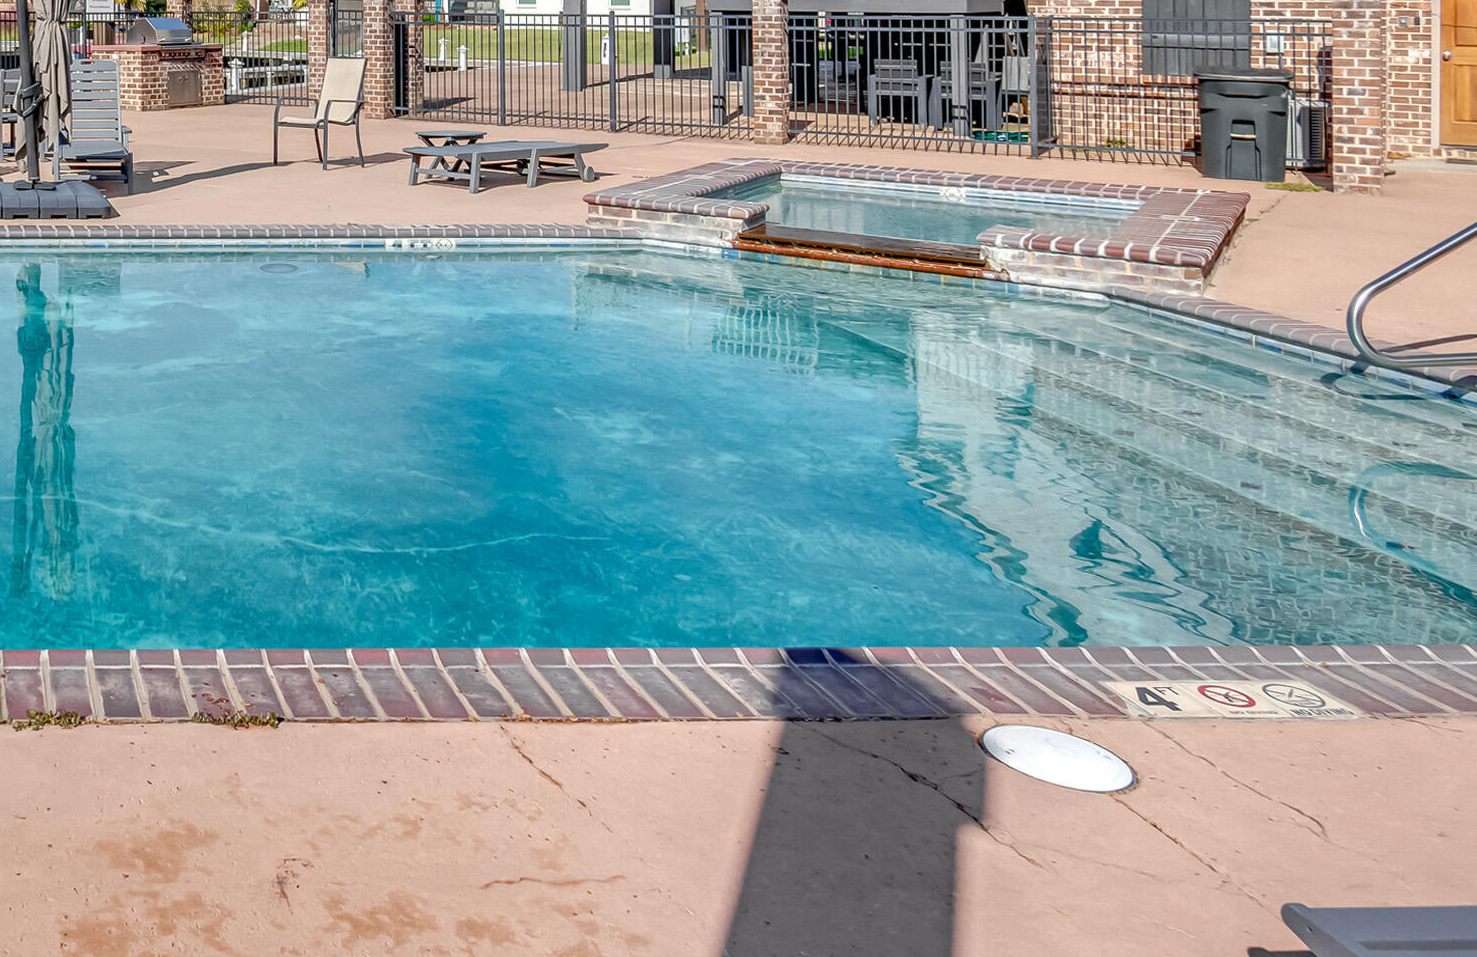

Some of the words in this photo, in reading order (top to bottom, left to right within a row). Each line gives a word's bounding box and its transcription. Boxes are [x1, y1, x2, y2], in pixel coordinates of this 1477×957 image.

[1152, 686, 1180, 695] FT
[1135, 686, 1183, 711] 4
[1309, 708, 1355, 716] DIVING
